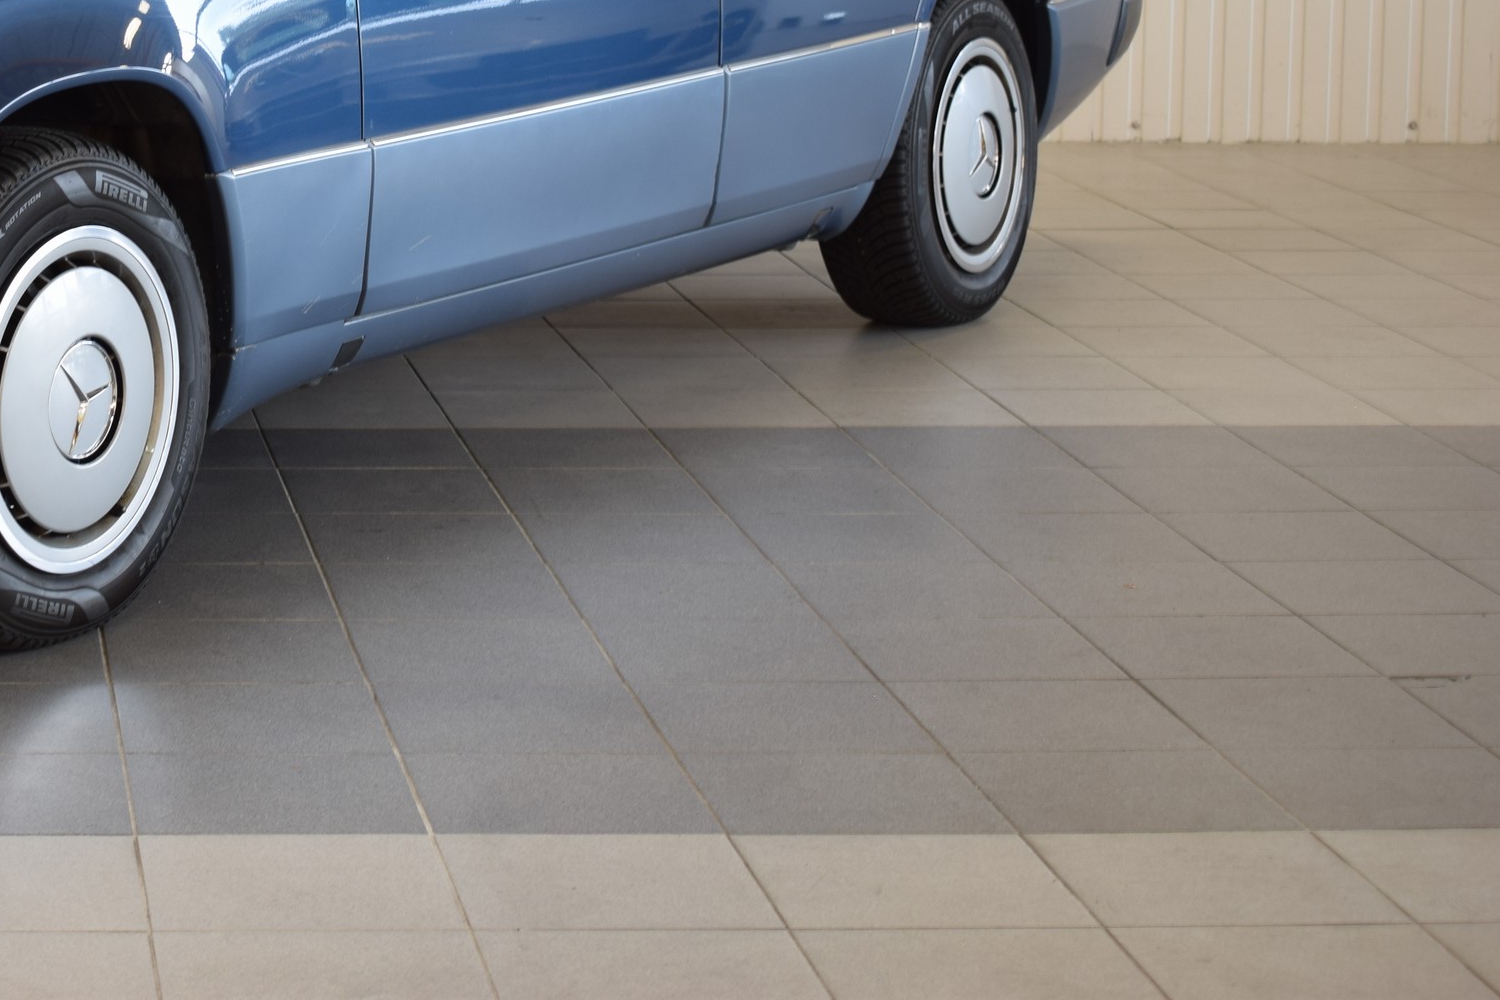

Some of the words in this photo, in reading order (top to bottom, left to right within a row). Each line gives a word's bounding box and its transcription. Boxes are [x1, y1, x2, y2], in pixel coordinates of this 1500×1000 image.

[952, 5, 971, 36] ALL
[94, 169, 149, 213] PIRELLI
[4, 190, 42, 231] ROTATION
[10, 592, 75, 626] PIRELLI
